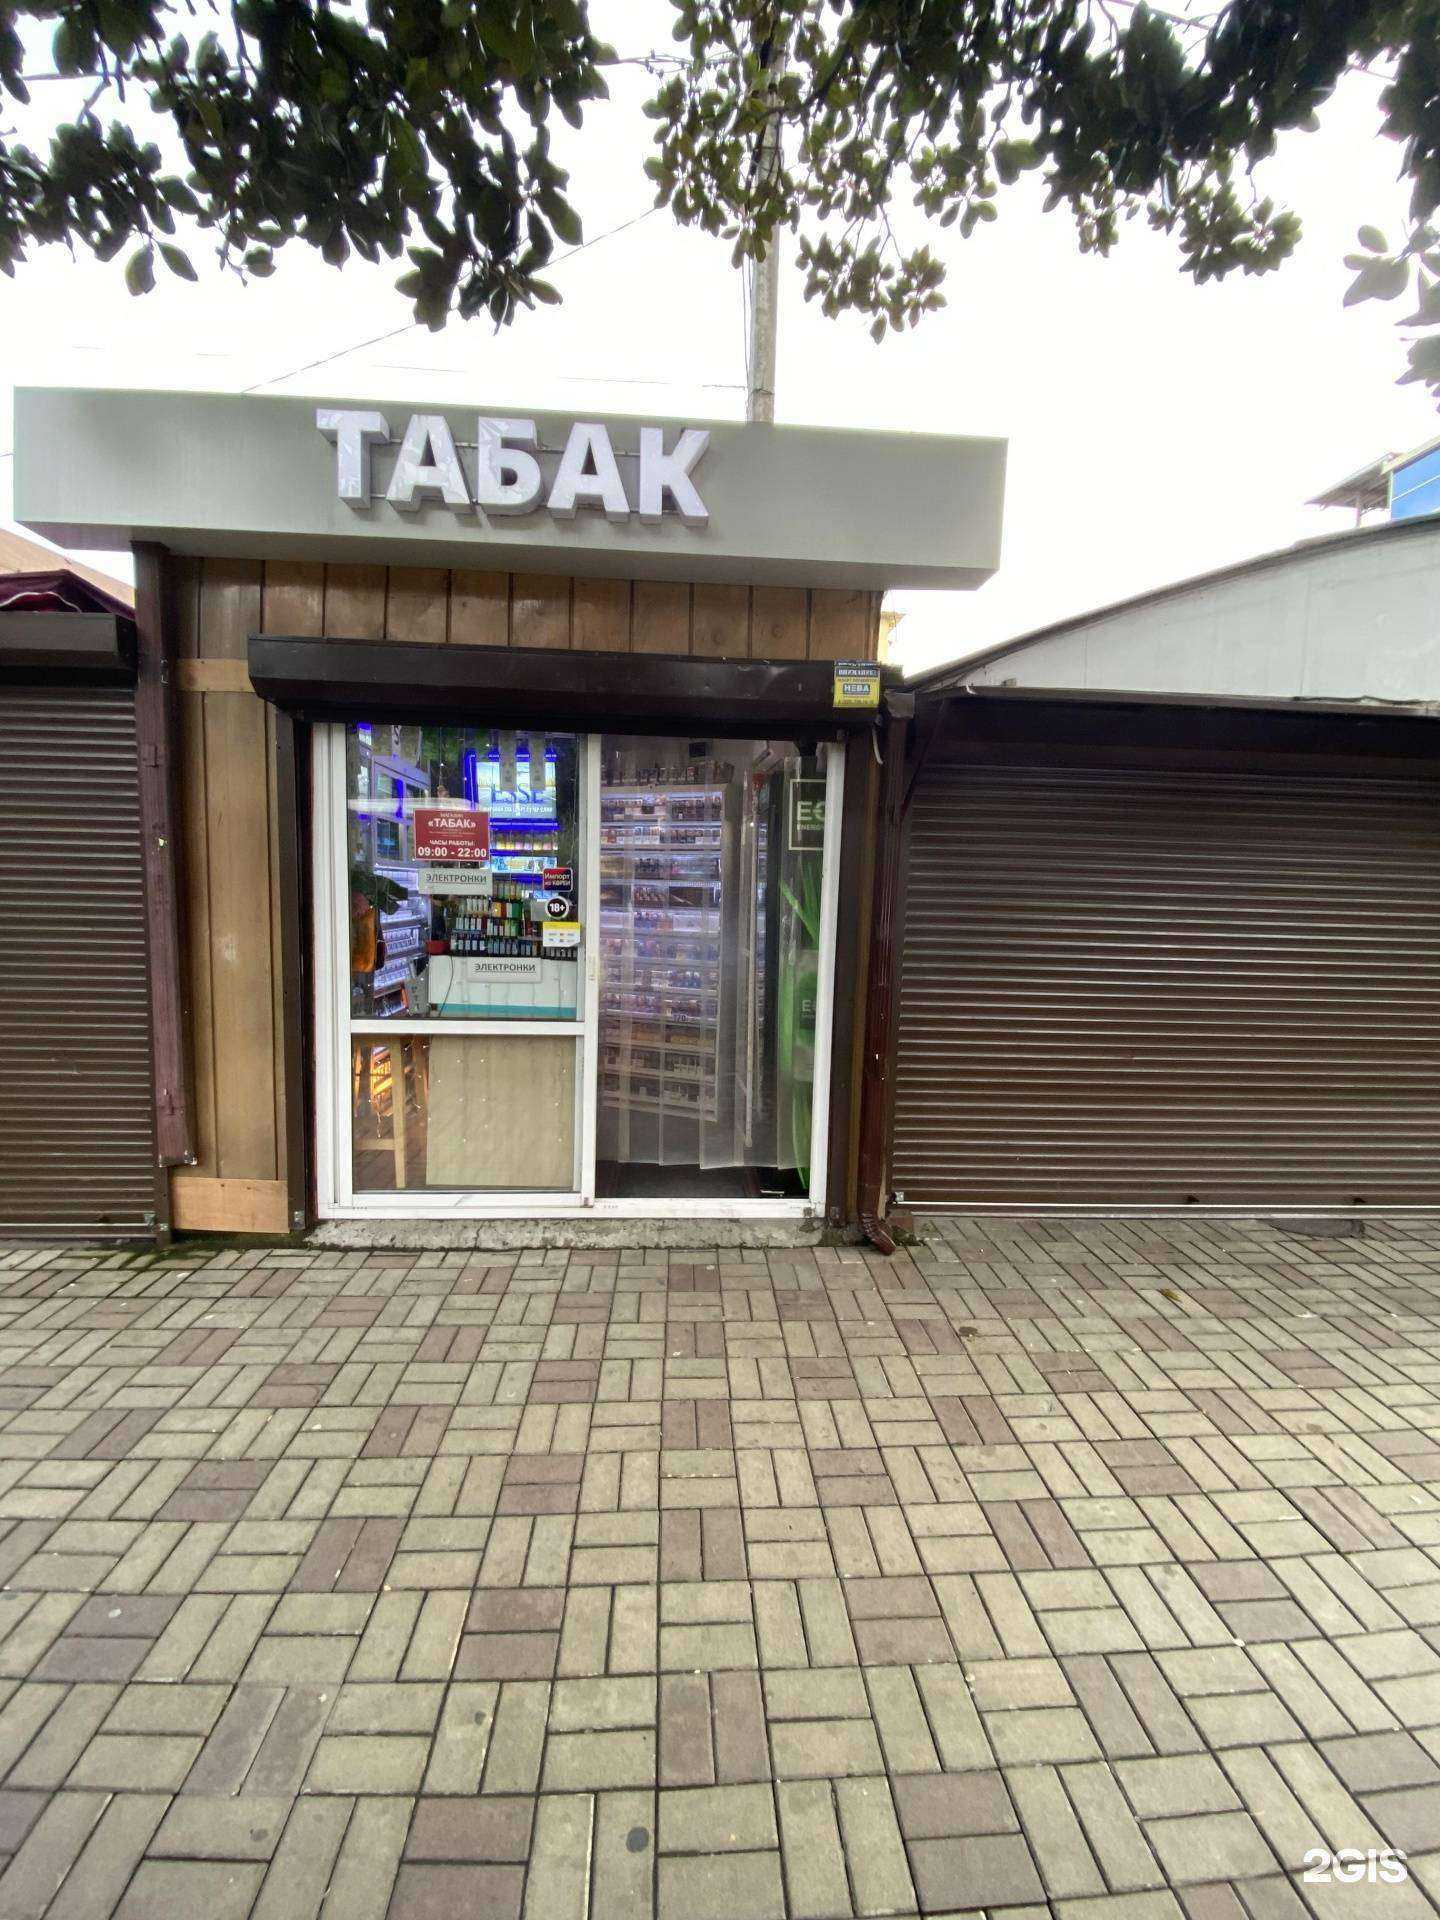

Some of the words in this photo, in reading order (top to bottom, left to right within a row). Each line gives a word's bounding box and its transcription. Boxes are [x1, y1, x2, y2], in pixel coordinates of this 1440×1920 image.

[316, 408, 710, 525] ТАБАК
[428, 818, 477, 829] «ТАБАК»
[417, 846, 448, 857] 09:00
[457, 848, 487, 858] 22:00
[425, 873, 487, 883] ЭЛЕКТРОНКИ
[549, 902, 566, 913] 18+
[474, 963, 536, 972] ЭЛЕКТРОНКИ
